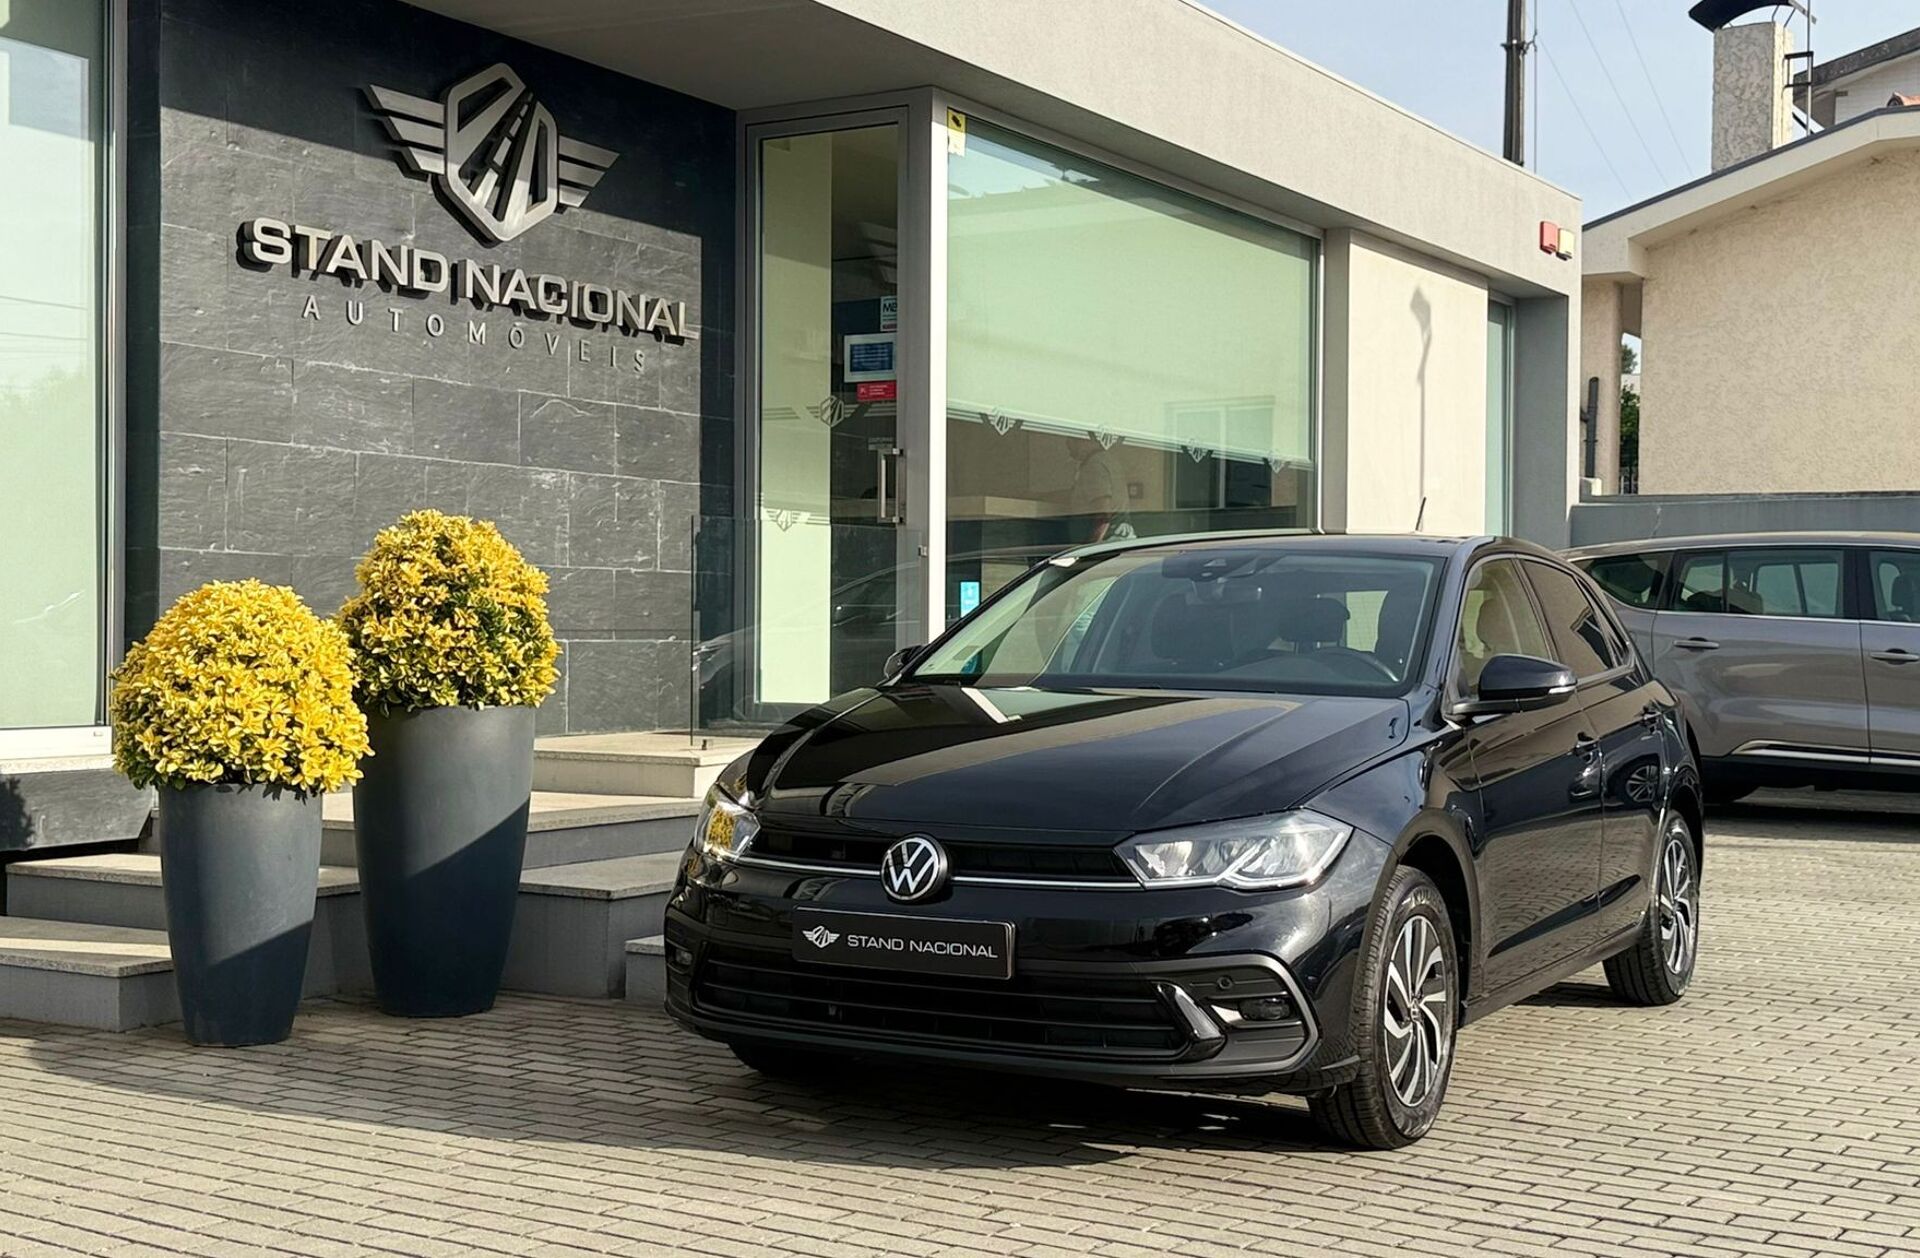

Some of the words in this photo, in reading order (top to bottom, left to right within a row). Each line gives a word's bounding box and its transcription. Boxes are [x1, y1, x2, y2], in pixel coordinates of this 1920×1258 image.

[251, 217, 449, 293] STAND
[463, 259, 700, 340] NACIONAL
[886, 840, 936, 894] VW
[847, 934, 904, 951] STAND
[909, 941, 998, 958] NACIONAL
